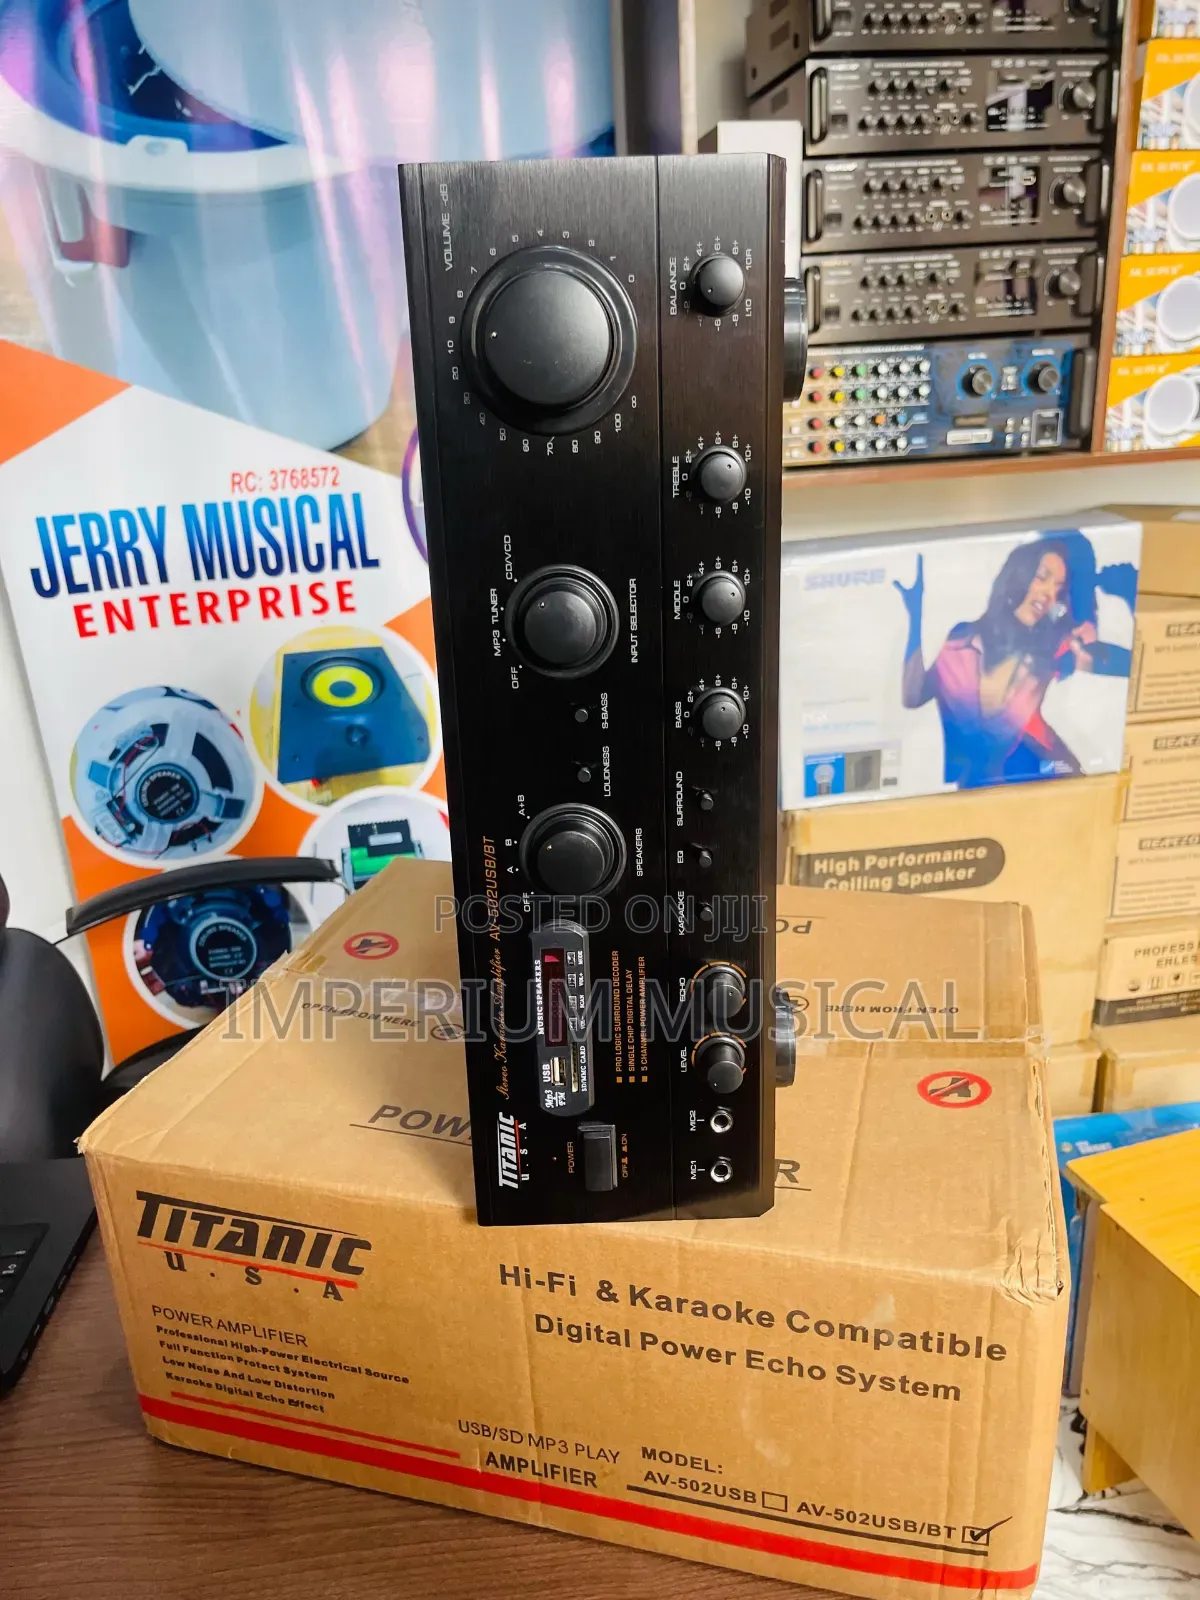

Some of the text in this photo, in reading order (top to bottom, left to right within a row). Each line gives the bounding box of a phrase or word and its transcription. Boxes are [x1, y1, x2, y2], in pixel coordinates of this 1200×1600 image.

[444, 213, 454, 271] VOLUME
[512, 234, 519, 242] 5
[536, 229, 544, 237] 4
[562, 231, 570, 239] 3
[628, 275, 635, 283] 0
[670, 256, 678, 316] BALANCE
[680, 282, 686, 290] 0
[448, 340, 454, 354] 10
[452, 366, 459, 381] 20
[594, 430, 602, 444] 90
[614, 412, 622, 434] 100
[230, 466, 341, 494] RC: 3768572
[672, 456, 680, 498] TREBLE
[682, 473, 688, 481] 0
[30, 492, 381, 599] JERRY MUSICAL
[504, 534, 513, 580] CD/VCD
[72, 579, 358, 639] ENTERPRISE
[490, 588, 499, 624] TUNER
[628, 578, 638, 664] INPUT SELECTOR
[492, 630, 502, 657] MP3
[510, 666, 519, 690] OFF
[600, 692, 609, 730] S-BASS
[602, 746, 611, 797] LOUDNESS
[518, 794, 526, 816] A+B
[676, 771, 684, 826] SURROUND
[505, 838, 512, 846] B
[635, 828, 644, 877] SPEAKERS
[677, 850, 684, 864] EQ
[814, 844, 988, 876] High Performance
[506, 866, 514, 874] A
[823, 866, 977, 892] Ceiling Speaker
[482, 836, 501, 942] AV-502USB/BT
[522, 892, 530, 912] OFF
[612, 950, 620, 986] DECODER
[638, 956, 646, 998] AMPLIFIER
[302, 1002, 422, 1028] OPEN FROM HERE
[534, 959, 545, 1035] MUSIC SPEAKERS
[612, 988, 621, 1032] SURROUND
[626, 995, 634, 1024] DIGITAL
[492, 1009, 508, 1063] Karaoke
[627, 1025, 635, 1043] CHIP
[496, 1066, 510, 1100] Stereo
[542, 1064, 551, 1082] USB
[566, 1142, 575, 1174] POWER
[136, 1190, 372, 1276] TITANIC
[152, 1304, 308, 1348] POWER AMPLIFIER
[499, 1263, 1008, 1362] Hi-Fi & Karaoke Compatible
[156, 1324, 410, 1384] Professional High-Power Electrical Source
[159, 1340, 328, 1382] Full Function Protect System
[534, 1313, 962, 1402] Digital Power Echo System
[162, 1356, 336, 1400] Low Noise And Low Distortion
[165, 1371, 325, 1413] Karaoke Digital Echo Effect
[458, 1418, 620, 1464] USB/SD MP3 PLAY
[485, 1450, 598, 1489] AMPLIFIER
[640, 1446, 724, 1475] MODEL:
[643, 1470, 957, 1540] AV-502USB AV-502USB/BT
